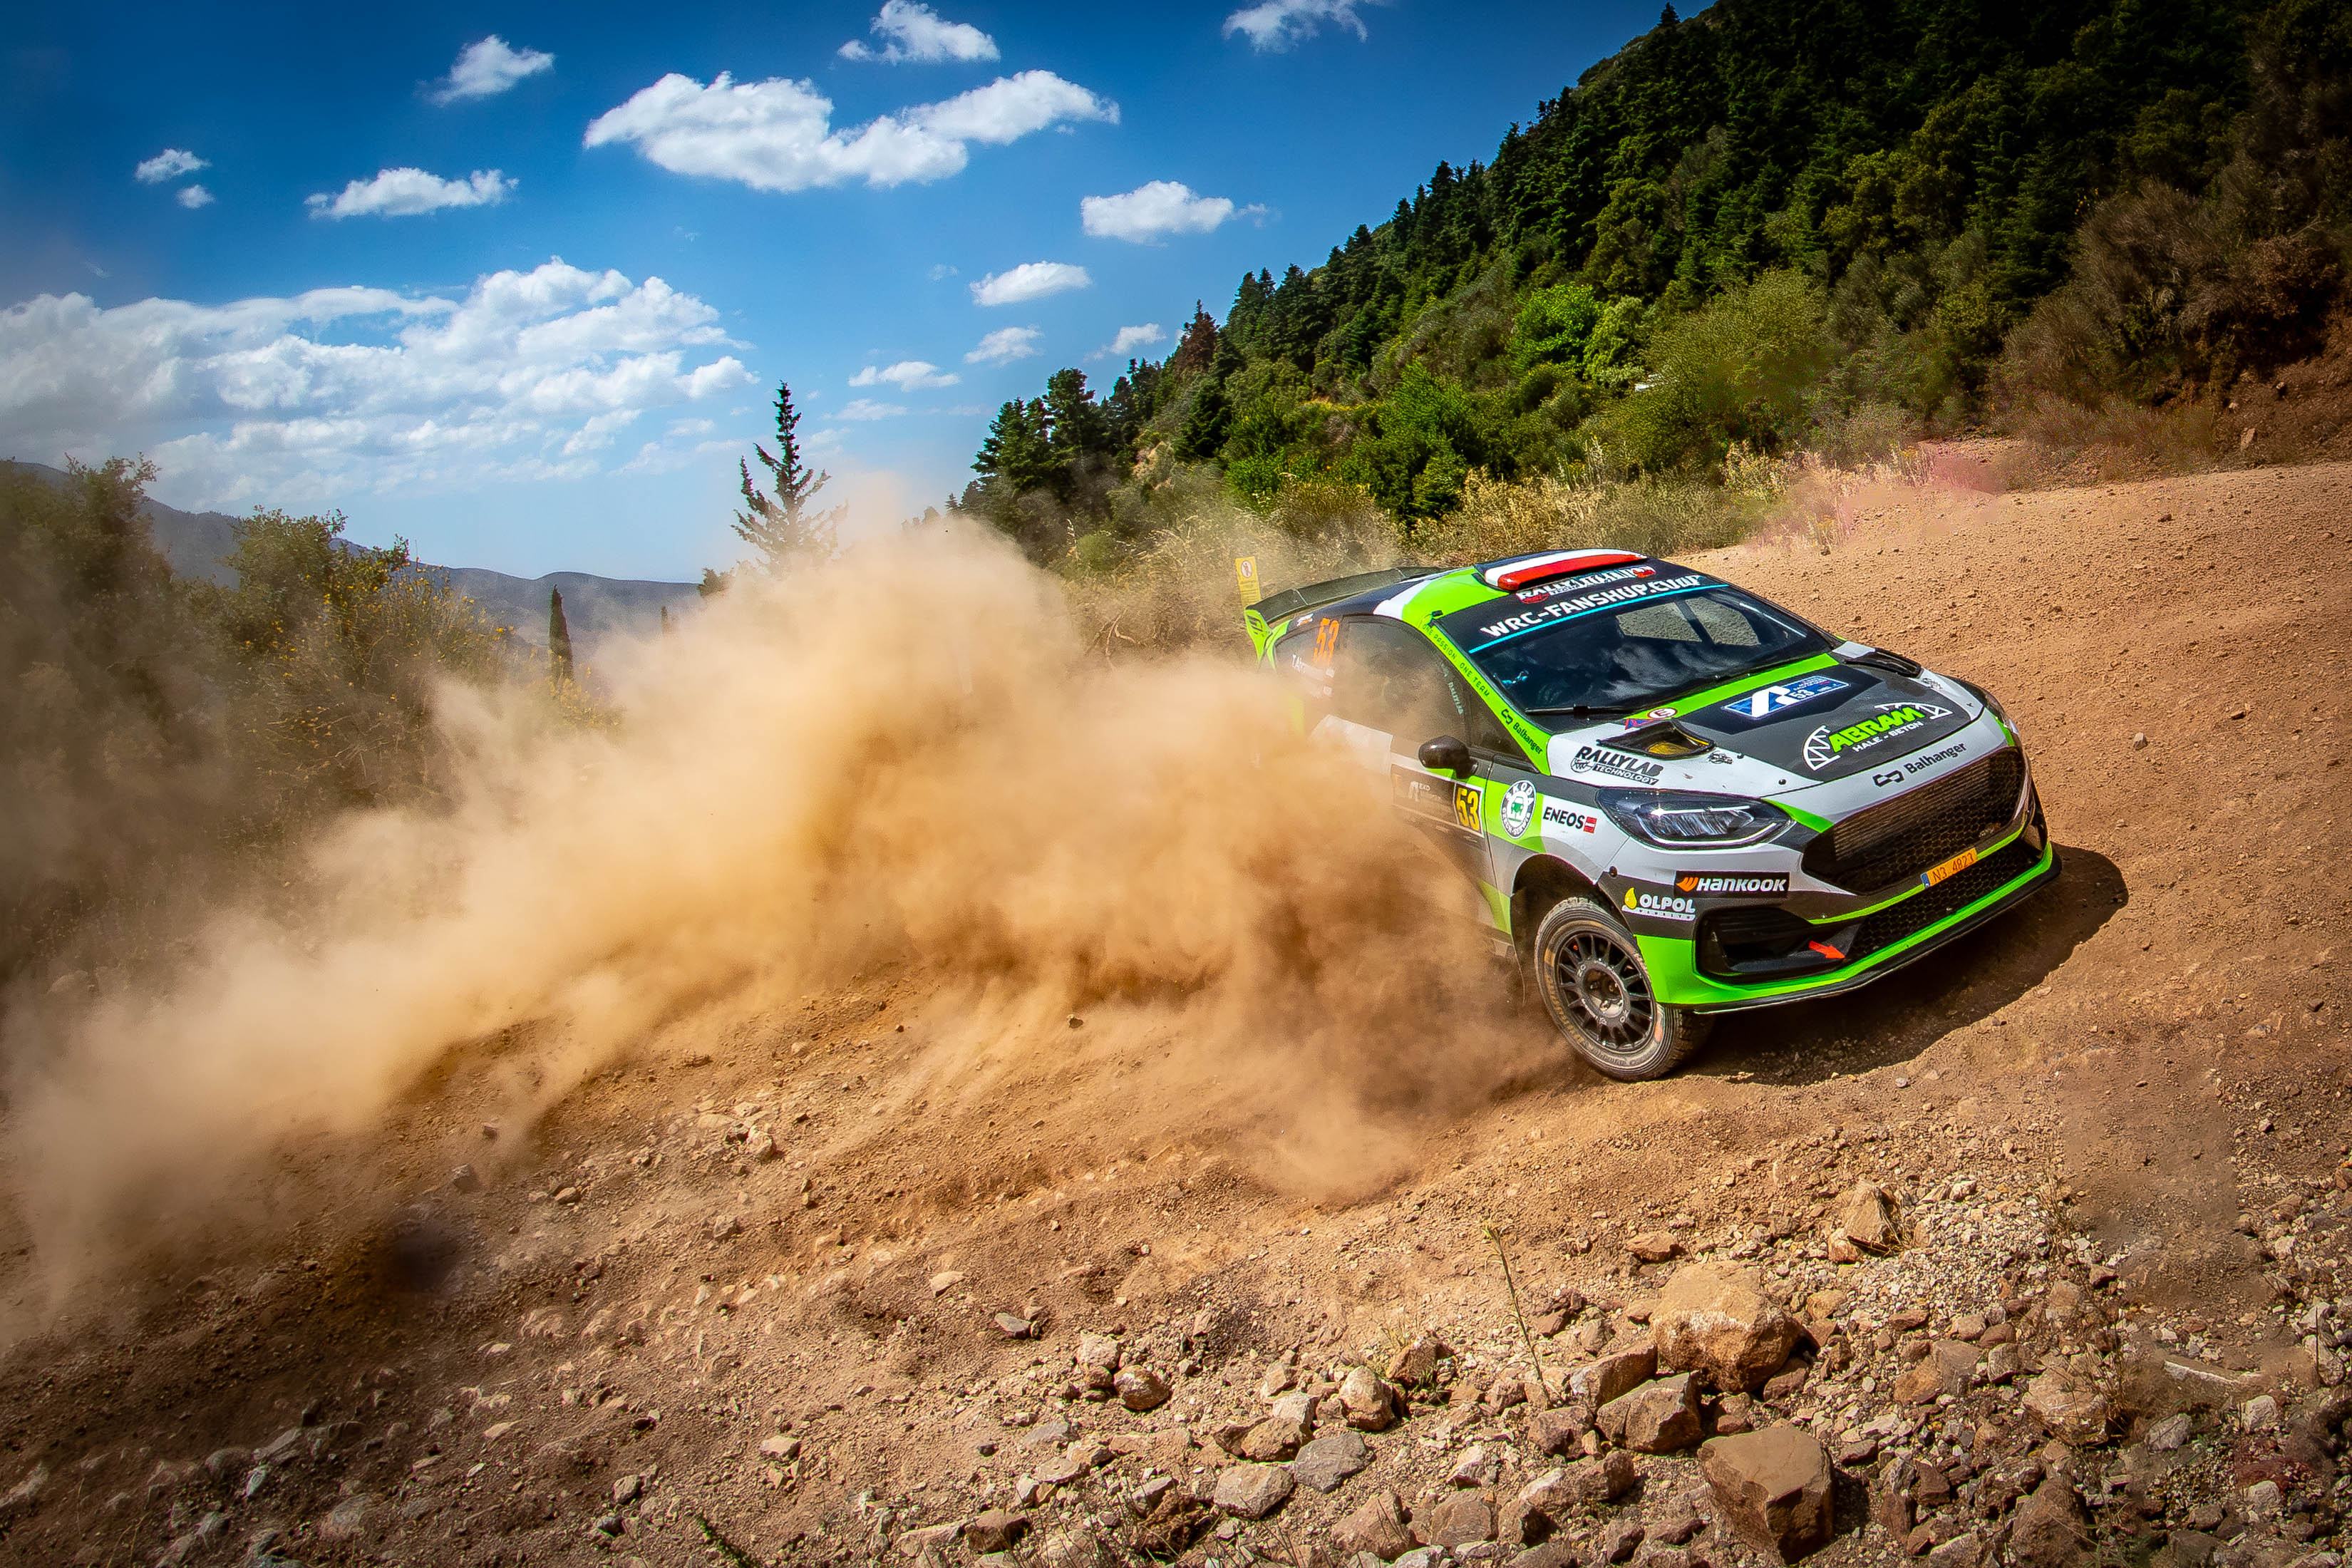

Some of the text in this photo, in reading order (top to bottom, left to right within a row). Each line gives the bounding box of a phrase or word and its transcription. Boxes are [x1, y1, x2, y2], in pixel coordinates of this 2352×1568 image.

[1459, 662, 1472, 676] ONE
[1788, 689, 1815, 699] 53
[1513, 722, 1543, 755] Balhanger
[1828, 706, 1926, 753] ABRAM
[1852, 736, 1883, 752] HALE
[1889, 721, 1924, 737] BETON
[1574, 746, 1664, 777] RALLYLAB
[1904, 742, 1967, 774] Balhanger
[1594, 763, 1659, 785] TECHNOLOGY
[1456, 787, 1480, 831] 53
[1542, 806, 1585, 830] ENEOS
[1639, 894, 1696, 913] OLPOL
